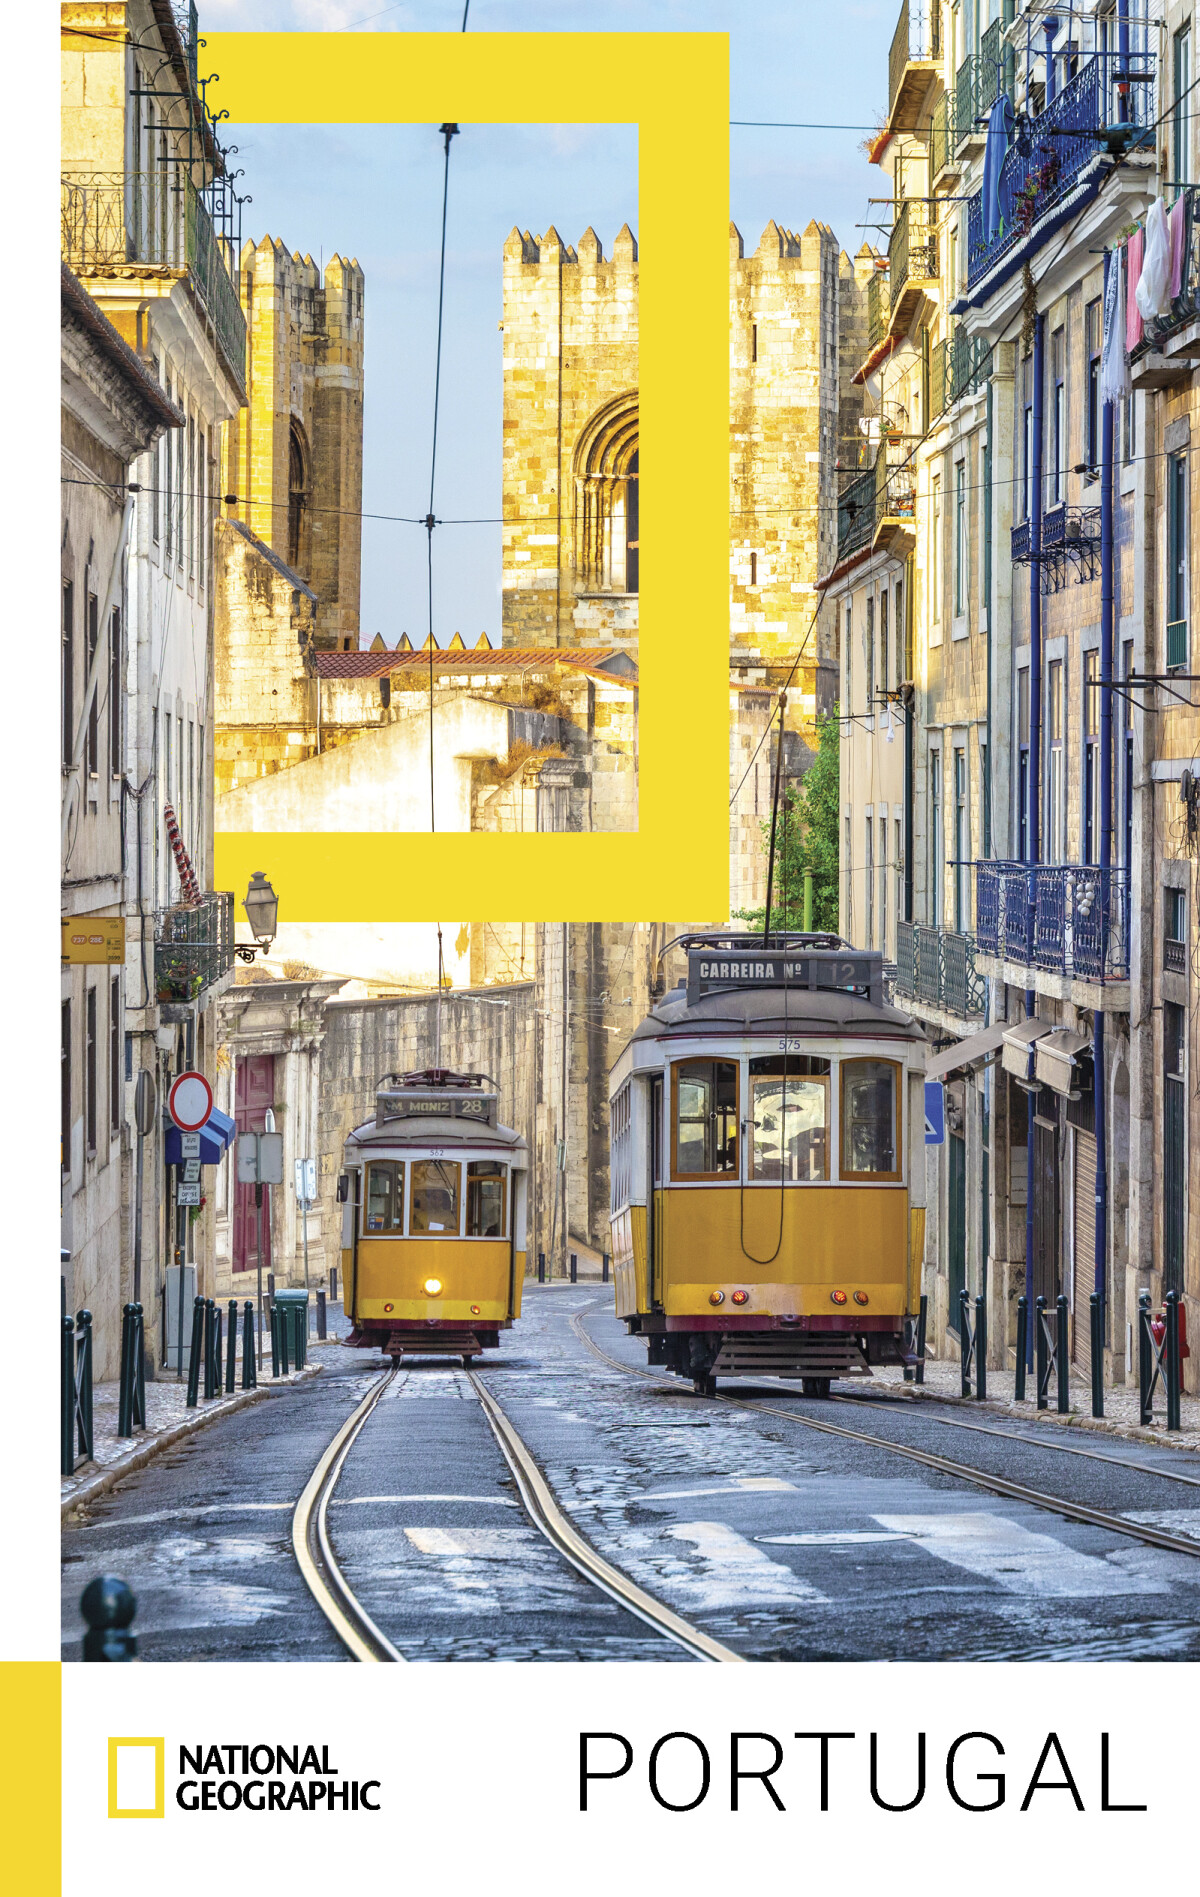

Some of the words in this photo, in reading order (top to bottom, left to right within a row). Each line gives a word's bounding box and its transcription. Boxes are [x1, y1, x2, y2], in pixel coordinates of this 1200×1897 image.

[700, 963, 774, 978] CARREIRA
[829, 962, 856, 984] 12
[778, 1039, 801, 1050] 575
[409, 1101, 450, 1112] MONIZ
[461, 1100, 482, 1113] 28
[430, 1149, 444, 1157] 562
